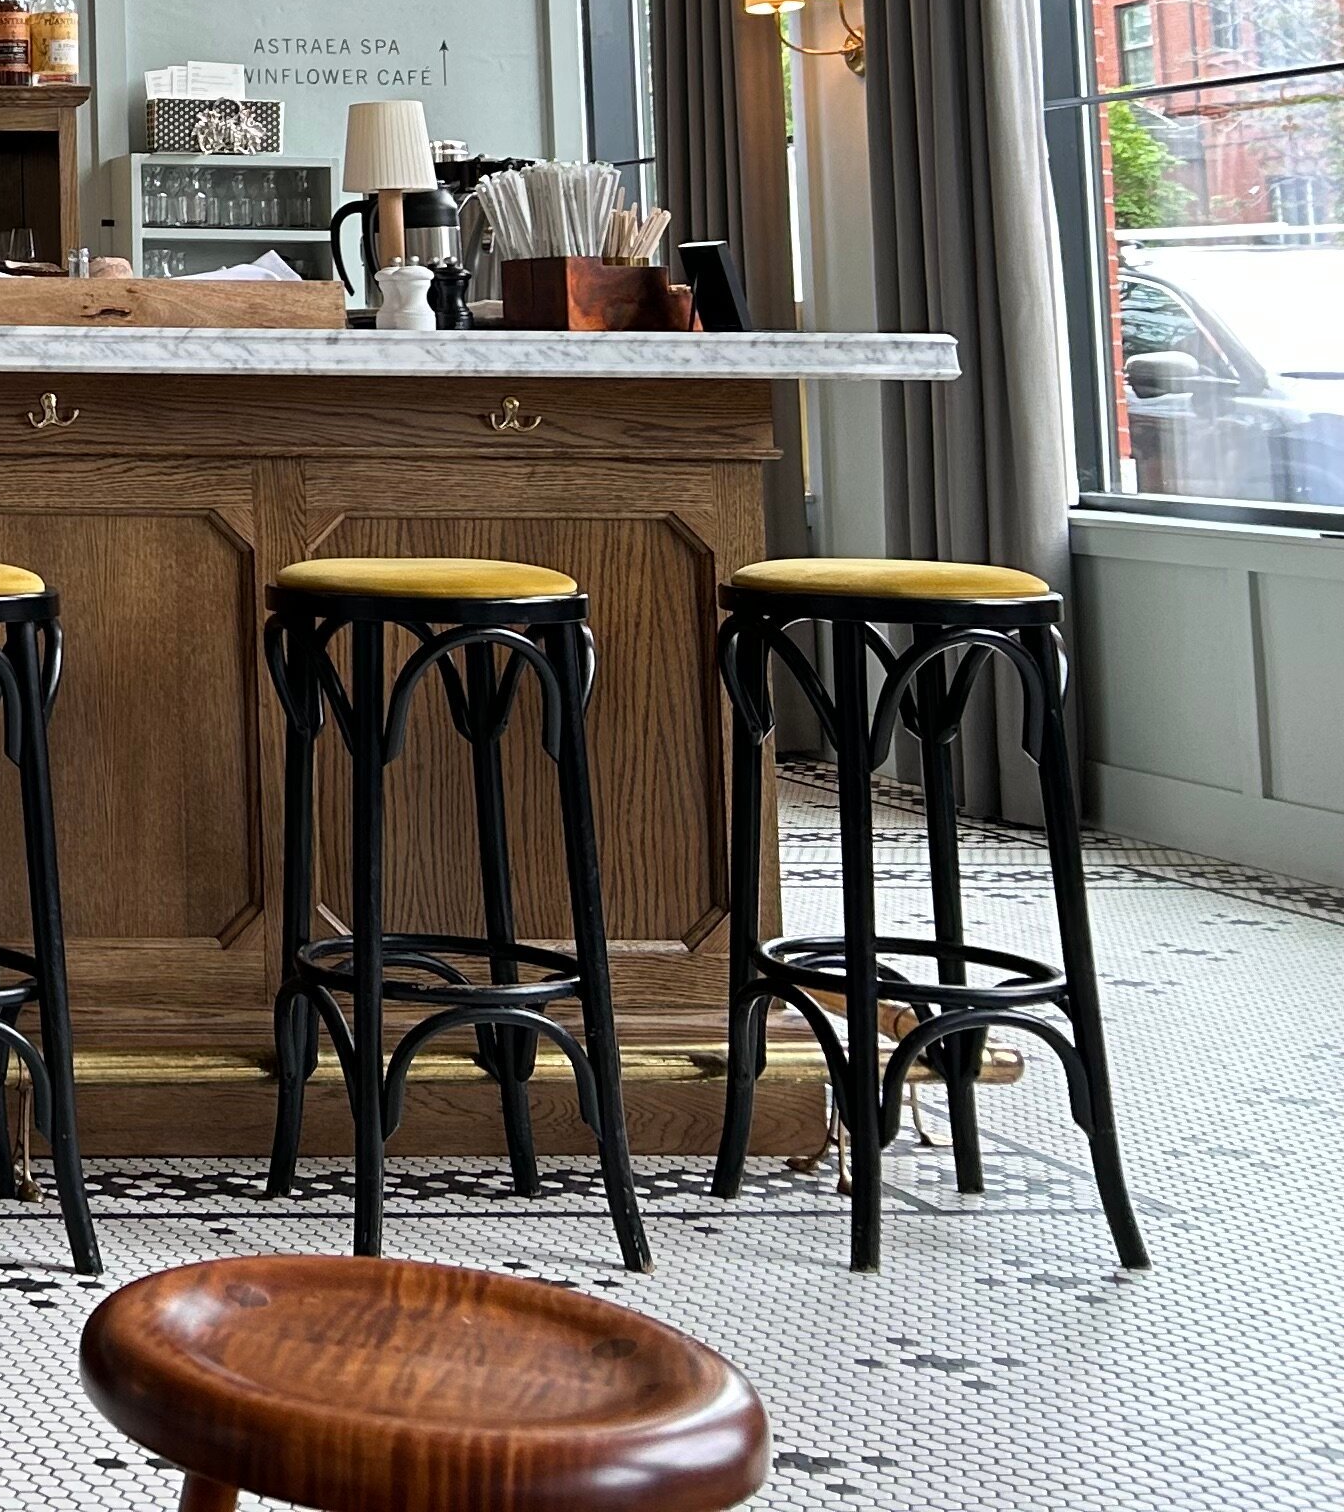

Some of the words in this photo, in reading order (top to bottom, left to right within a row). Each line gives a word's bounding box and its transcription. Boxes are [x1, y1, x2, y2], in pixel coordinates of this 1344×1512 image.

[254, 38, 351, 55] ASTRAEA
[361, 39, 400, 55] SPA
[377, 66, 433, 85] CAFÉ
